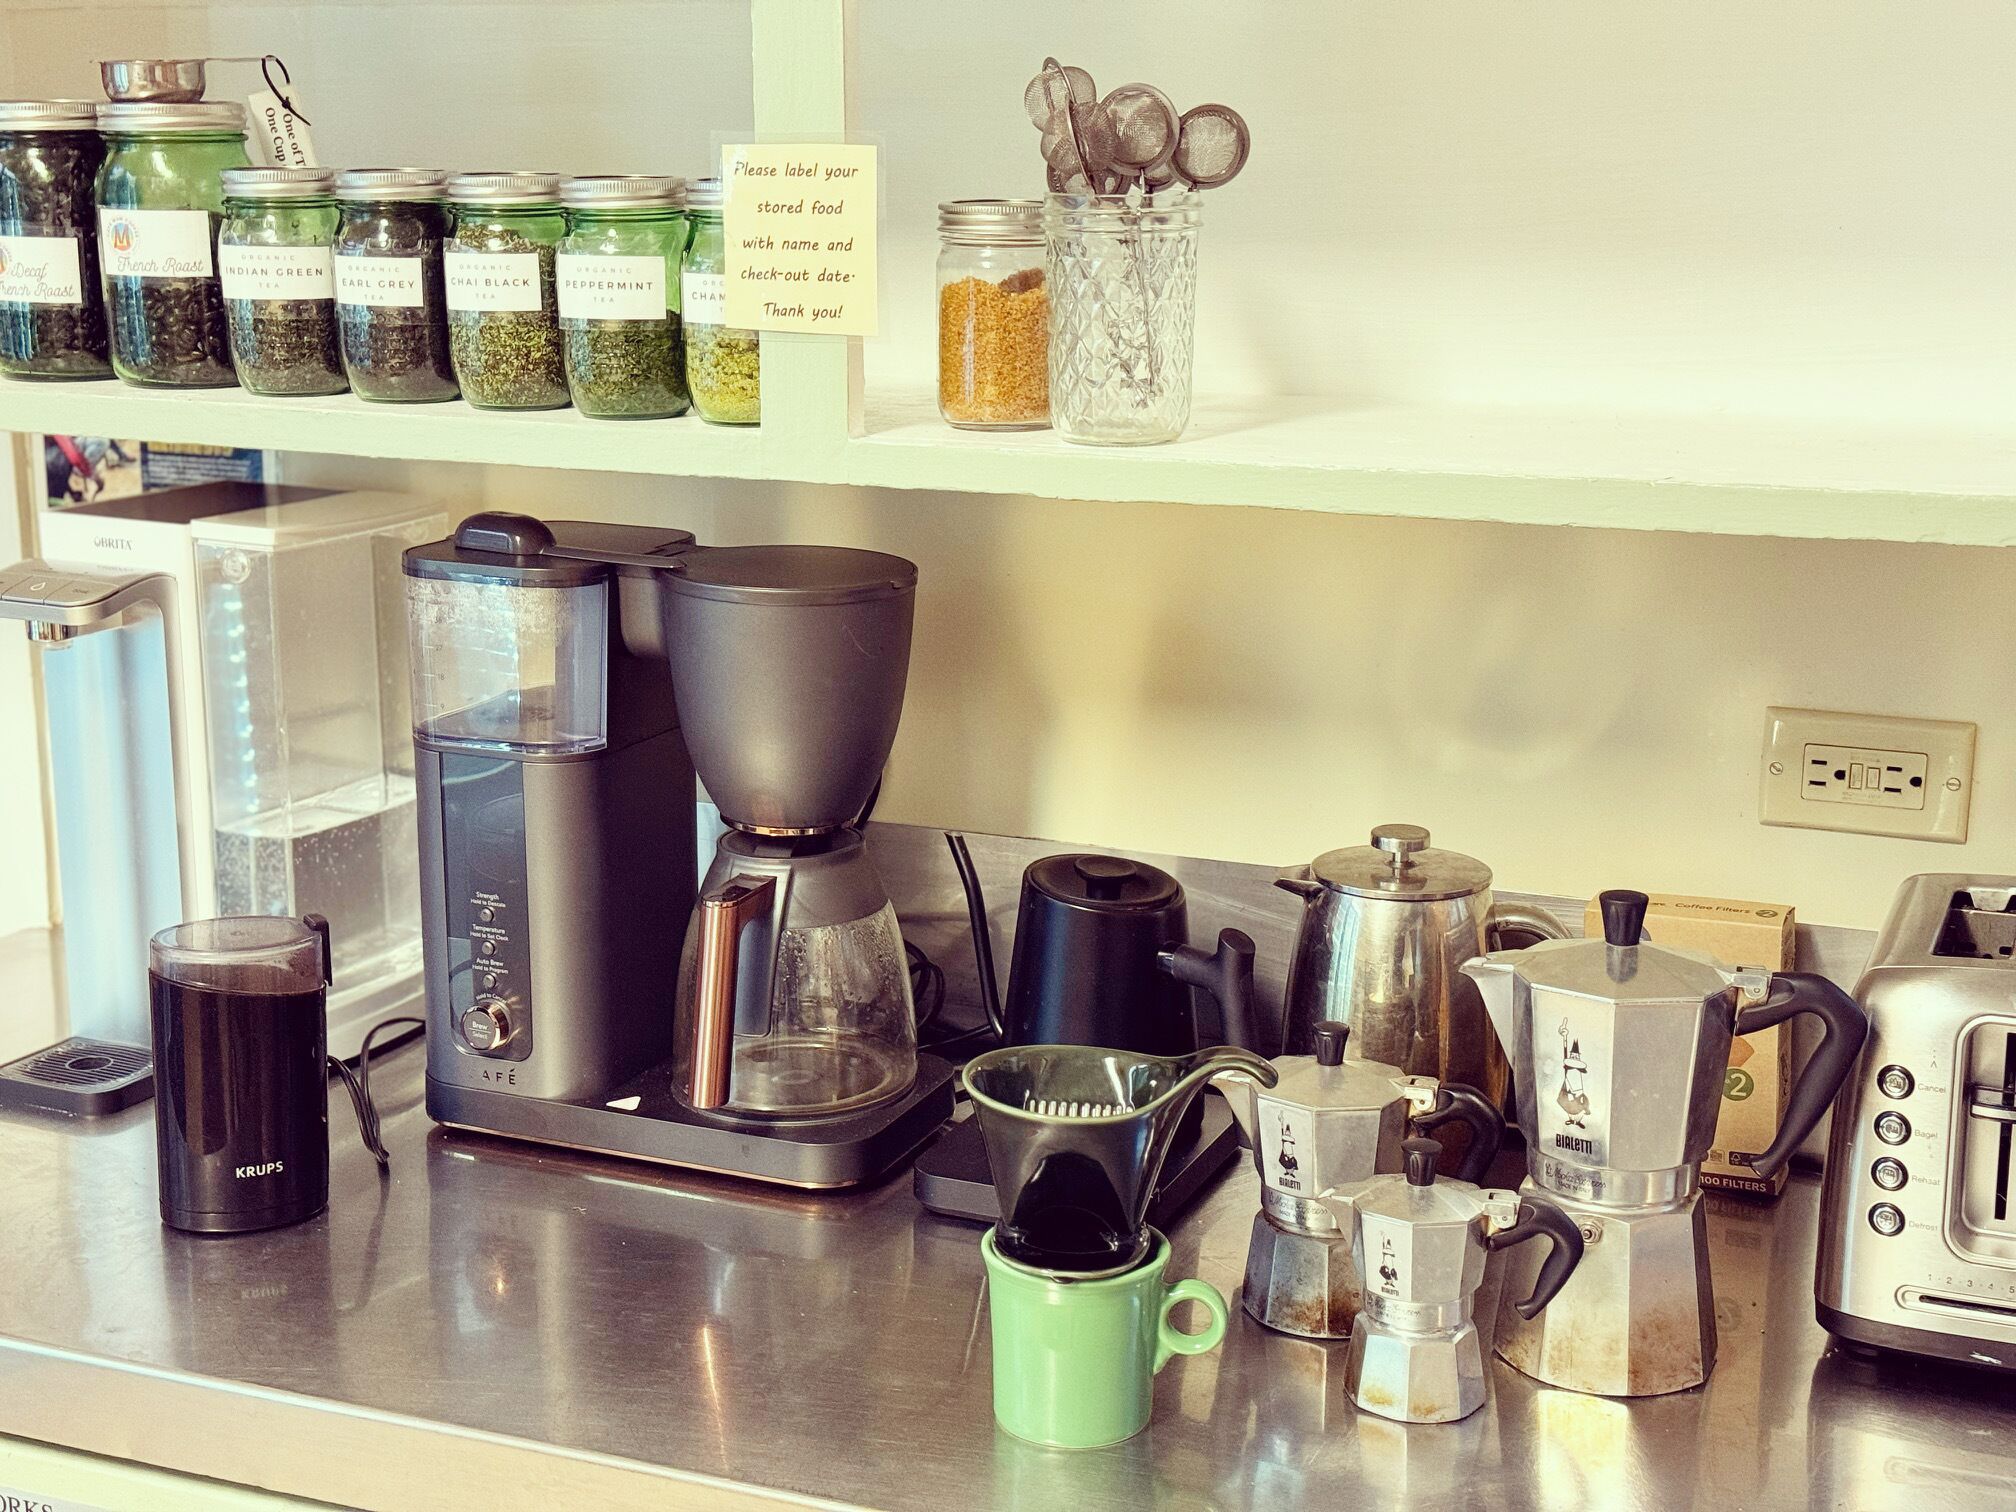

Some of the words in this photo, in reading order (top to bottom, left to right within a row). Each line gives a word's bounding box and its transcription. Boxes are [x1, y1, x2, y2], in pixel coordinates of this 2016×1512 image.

[265, 108, 278, 134] One
[274, 136, 286, 162] Cup
[283, 113, 296, 140] One
[290, 142, 304, 156] of
[734, 161, 778, 177] Please
[785, 163, 818, 178] label
[825, 166, 859, 182] your
[757, 199, 804, 214] stored
[812, 200, 844, 215] food
[742, 236, 774, 251] with
[782, 240, 820, 252] name
[827, 237, 854, 252] and
[11, 262, 48, 282] Decaf
[118, 256, 159, 272] French
[162, 257, 204, 276] Roast
[226, 266, 268, 276] INDIAN
[276, 268, 323, 276] GREEN
[740, 266, 810, 282] check-out
[342, 278, 372, 288] EARL
[378, 280, 415, 289] GREY
[450, 277, 478, 286] CHAI
[485, 278, 530, 287] BLACK
[566, 280, 653, 290] PEPPERMINT
[34, 282, 74, 300] Roast
[763, 302, 804, 318] Thank
[812, 306, 844, 322] you!
[101, 537, 132, 550] BRITA
[476, 891, 500, 900] Strength
[1675, 902, 1712, 910] Coffee
[1716, 906, 1751, 914] Filters
[472, 1021, 488, 1030] Brew
[1918, 1083, 1946, 1094] Cancel
[1914, 1129, 1938, 1140] Bagel
[235, 1160, 284, 1179] KRUPS
[1700, 1176, 1720, 1186] 100
[1722, 1178, 1767, 1192] FILTERS
[1912, 1175, 1940, 1186] Reheat
[1908, 1220, 1938, 1231] Defrost
[1946, 1276, 1952, 1284] 2
[1967, 1280, 1973, 1288] 3
[2009, 1286, 2015, 1294] 5
